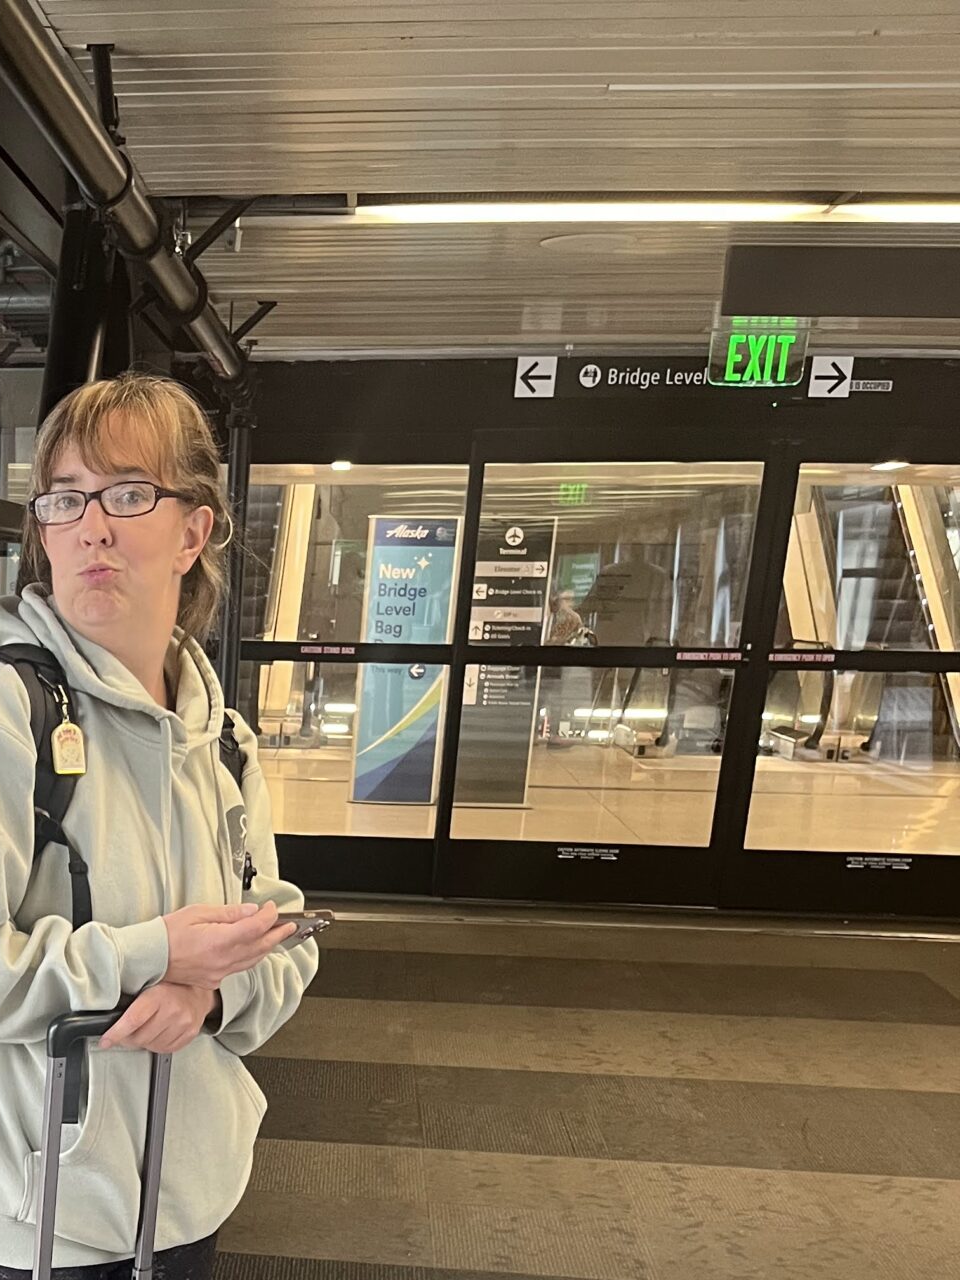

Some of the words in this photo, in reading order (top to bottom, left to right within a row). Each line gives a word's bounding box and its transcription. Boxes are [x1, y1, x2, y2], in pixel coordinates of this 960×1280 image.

[724, 334, 797, 382] EXIT
[607, 368, 661, 389] Bridge
[665, 367, 708, 385] Level
[862, 381, 890, 390] OCCUPIED
[560, 483, 589, 505] EXIT
[385, 524, 429, 540] Alaska
[499, 547, 528, 556] Terminal
[378, 563, 416, 580] New
[377, 583, 427, 600] Bridge
[376, 603, 416, 616] Level
[374, 620, 402, 638] Bag
[371, 666, 386, 675] This
